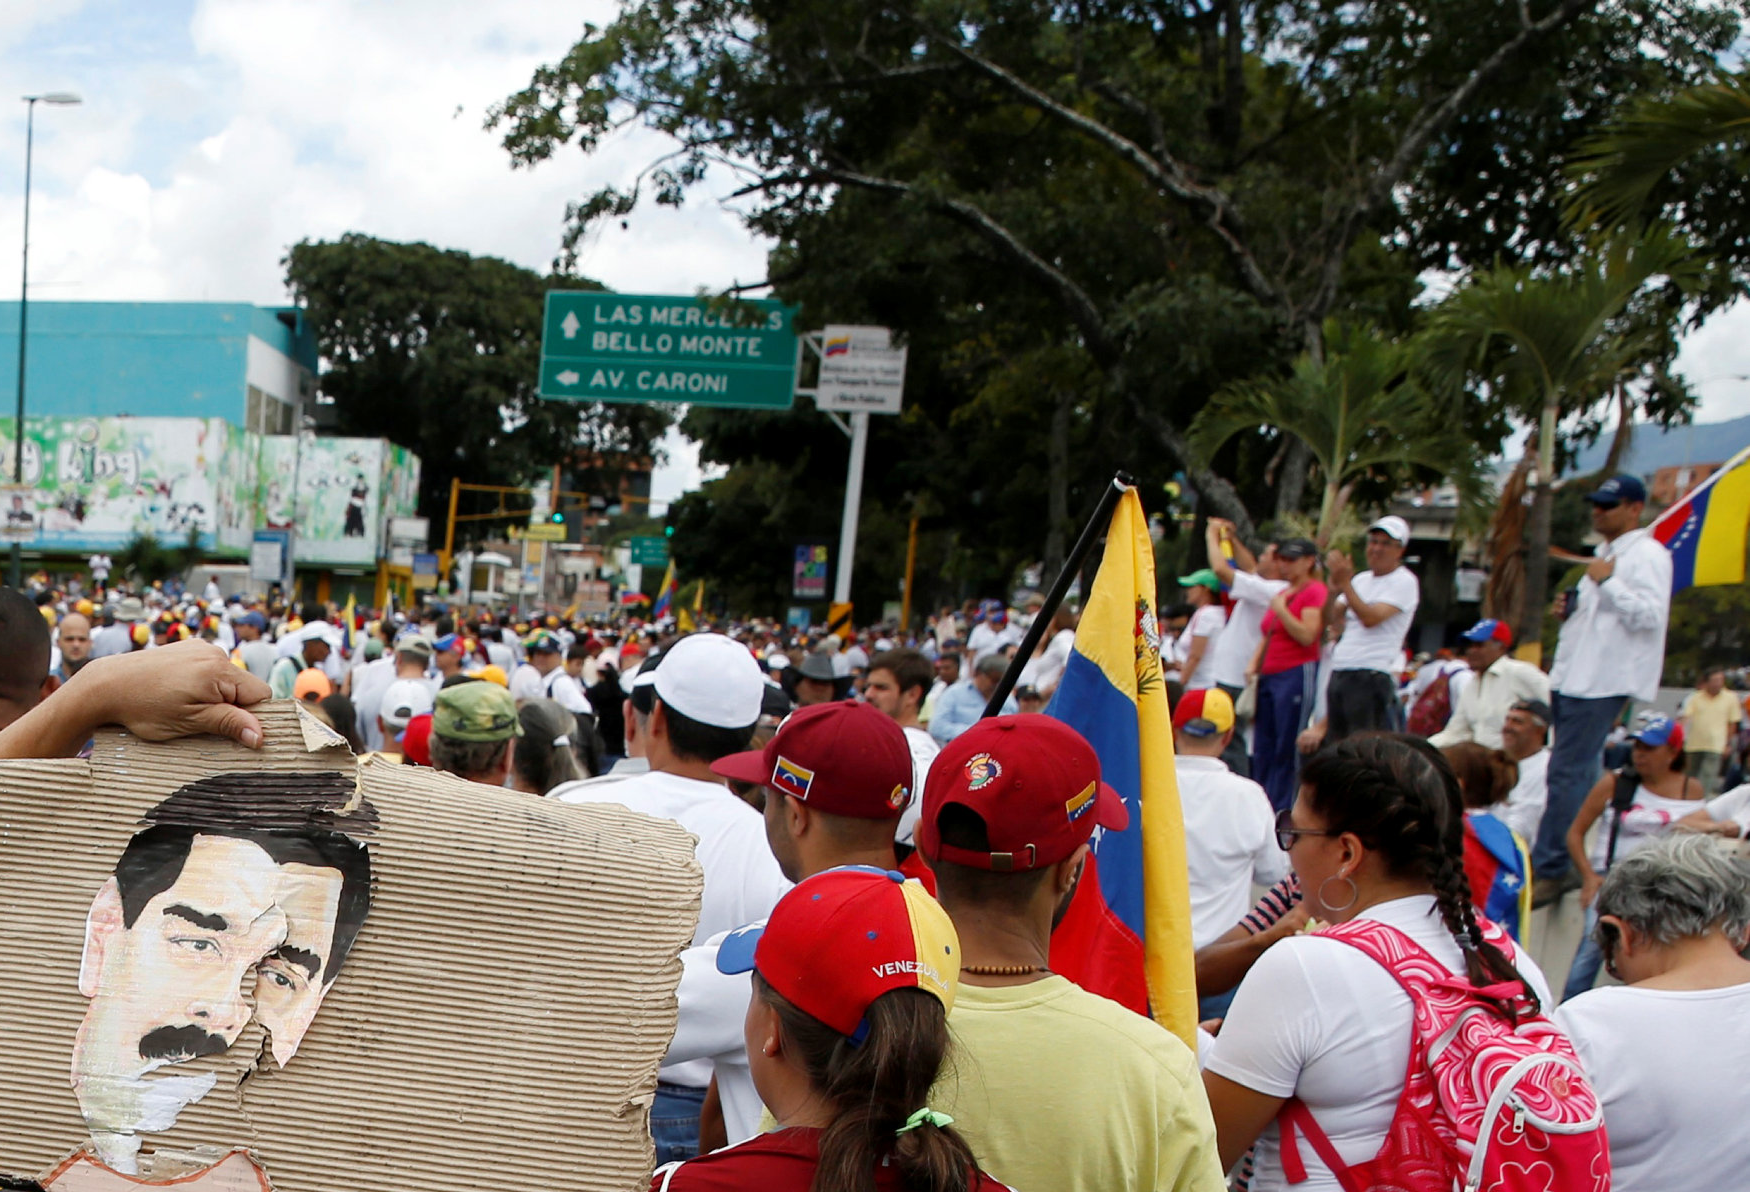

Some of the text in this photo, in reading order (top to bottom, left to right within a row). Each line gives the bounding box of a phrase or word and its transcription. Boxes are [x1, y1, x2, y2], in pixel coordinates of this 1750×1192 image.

[594, 305, 643, 325] LAS
[592, 331, 763, 358] BELLO MONTE
[590, 369, 728, 394] AV. CARONI
[872, 960, 949, 992] VENEZUELA
